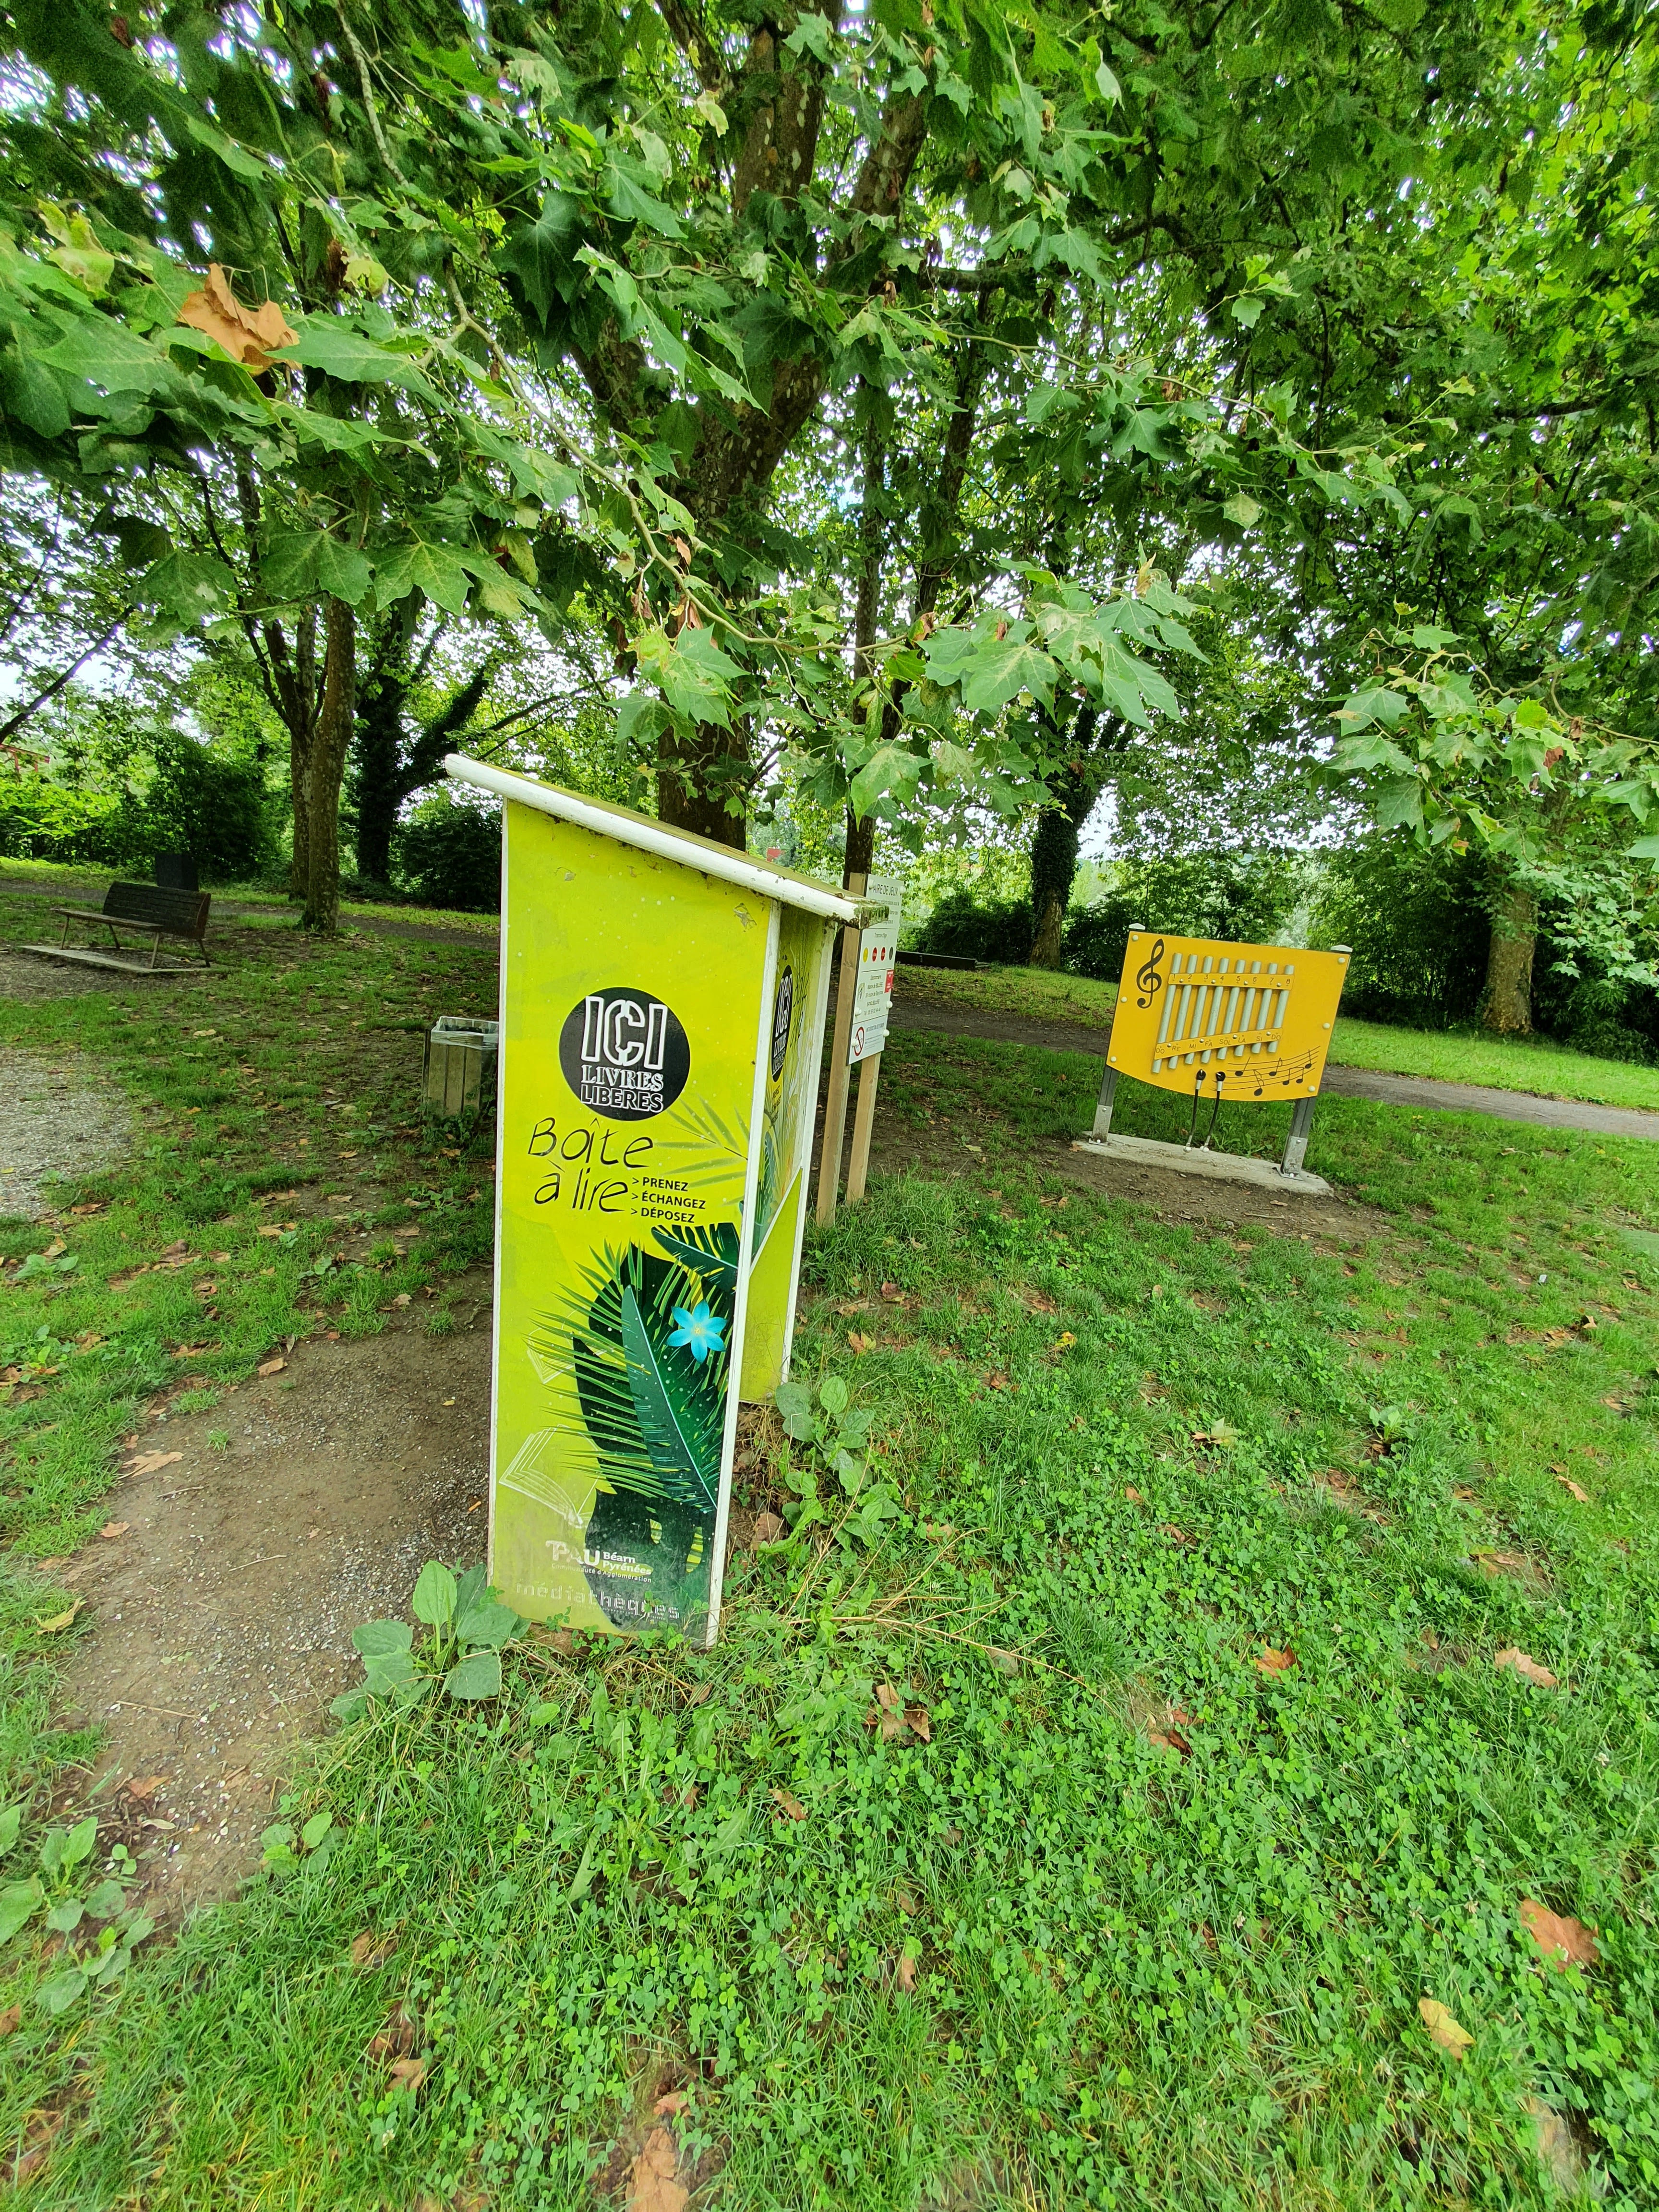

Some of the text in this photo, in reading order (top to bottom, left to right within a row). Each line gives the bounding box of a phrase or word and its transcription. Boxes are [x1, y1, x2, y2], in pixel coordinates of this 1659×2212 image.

[883, 885, 889, 895] DE
[889, 887, 898, 896] JEUX
[581, 996, 668, 1070] ICI
[581, 1064, 664, 1092] LIVRES
[581, 1084, 664, 1113] LIBERES
[528, 1118, 653, 1168] Boîte
[534, 1159, 628, 1212] à lire
[642, 1177, 689, 1191] PRENEZ
[641, 1192, 706, 1209] ÉCHANGEZ
[641, 1207, 695, 1223] DÉPOSEZ
[602, 1551, 636, 1563] Béarn
[551, 1563, 652, 1583] Communauté d'Agglomération
[602, 1561, 652, 1575] Pyrénées
